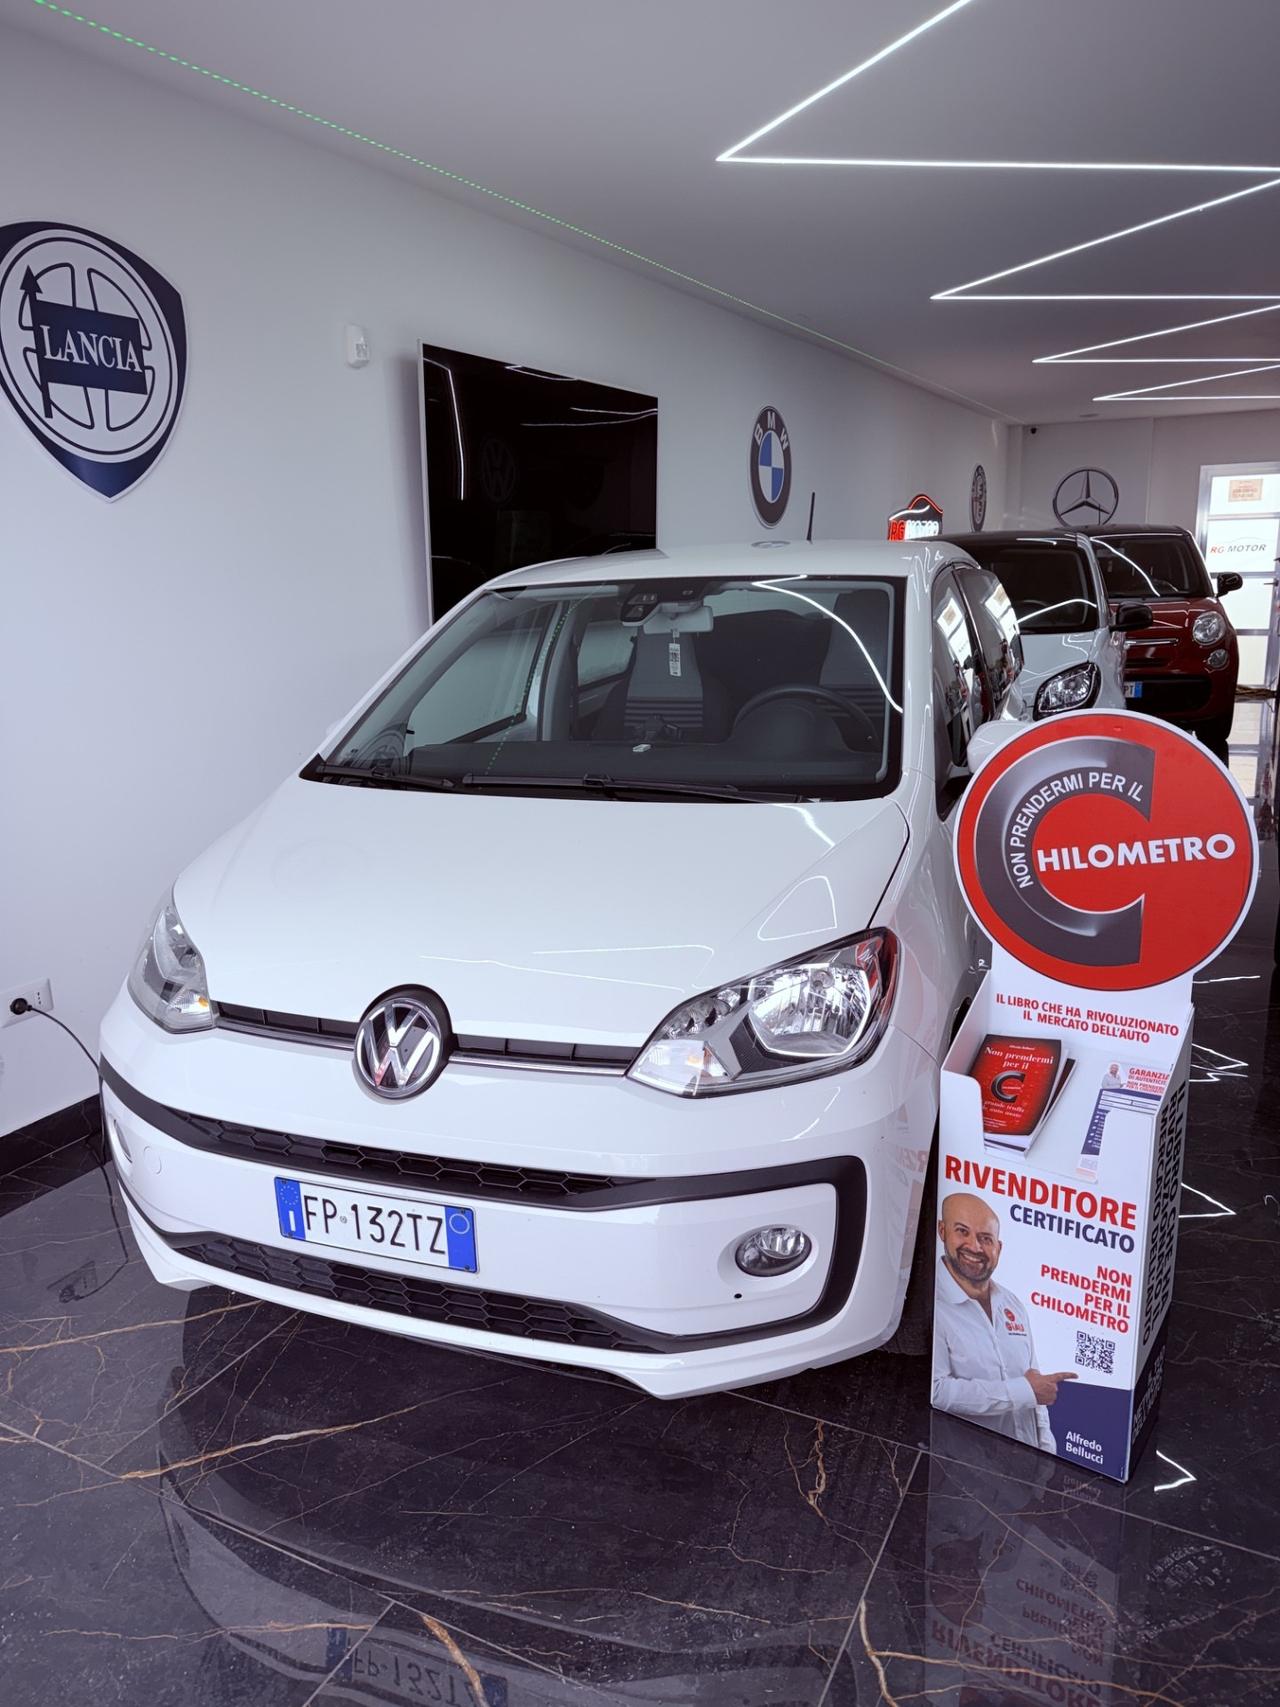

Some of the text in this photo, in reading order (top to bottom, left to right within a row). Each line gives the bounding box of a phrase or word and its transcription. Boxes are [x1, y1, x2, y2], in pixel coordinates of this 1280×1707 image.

[39, 324, 143, 373] LANCIA
[754, 410, 789, 451] BMW
[1210, 543, 1267, 554] RG MOTOR
[1009, 771, 1144, 889] NON PRENDERMI PER IL
[996, 993, 1179, 1036] IL LIBRO CHE HA RIVOLUZIONATO
[1023, 1010, 1150, 1044] IL MERCATO DELL'AUTO
[985, 1046, 1003, 1057] Non
[1004, 1052, 1055, 1065] prendermi
[1002, 1060, 1030, 1069] per il
[1153, 1104, 1168, 1221] MERCATO
[1170, 1112, 1183, 1202] LIBRO
[945, 1155, 1137, 1231] RIVENDITORE
[1154, 1090, 1178, 1300] RIVOLUZIONATO
[1009, 1203, 1135, 1253] CERTIFICATO
[1164, 1206, 1176, 1267] CHE
[1040, 1264, 1131, 1303] PRENDERMI
[1097, 1266, 1132, 1288] NON
[1160, 1266, 1172, 1314] HA
[1031, 1291, 1129, 1333] CHILOMETRO
[1084, 1293, 1130, 1319] PER IL
[1065, 1430, 1102, 1452] Alfredo
[1065, 1442, 1104, 1465] Bellucci
